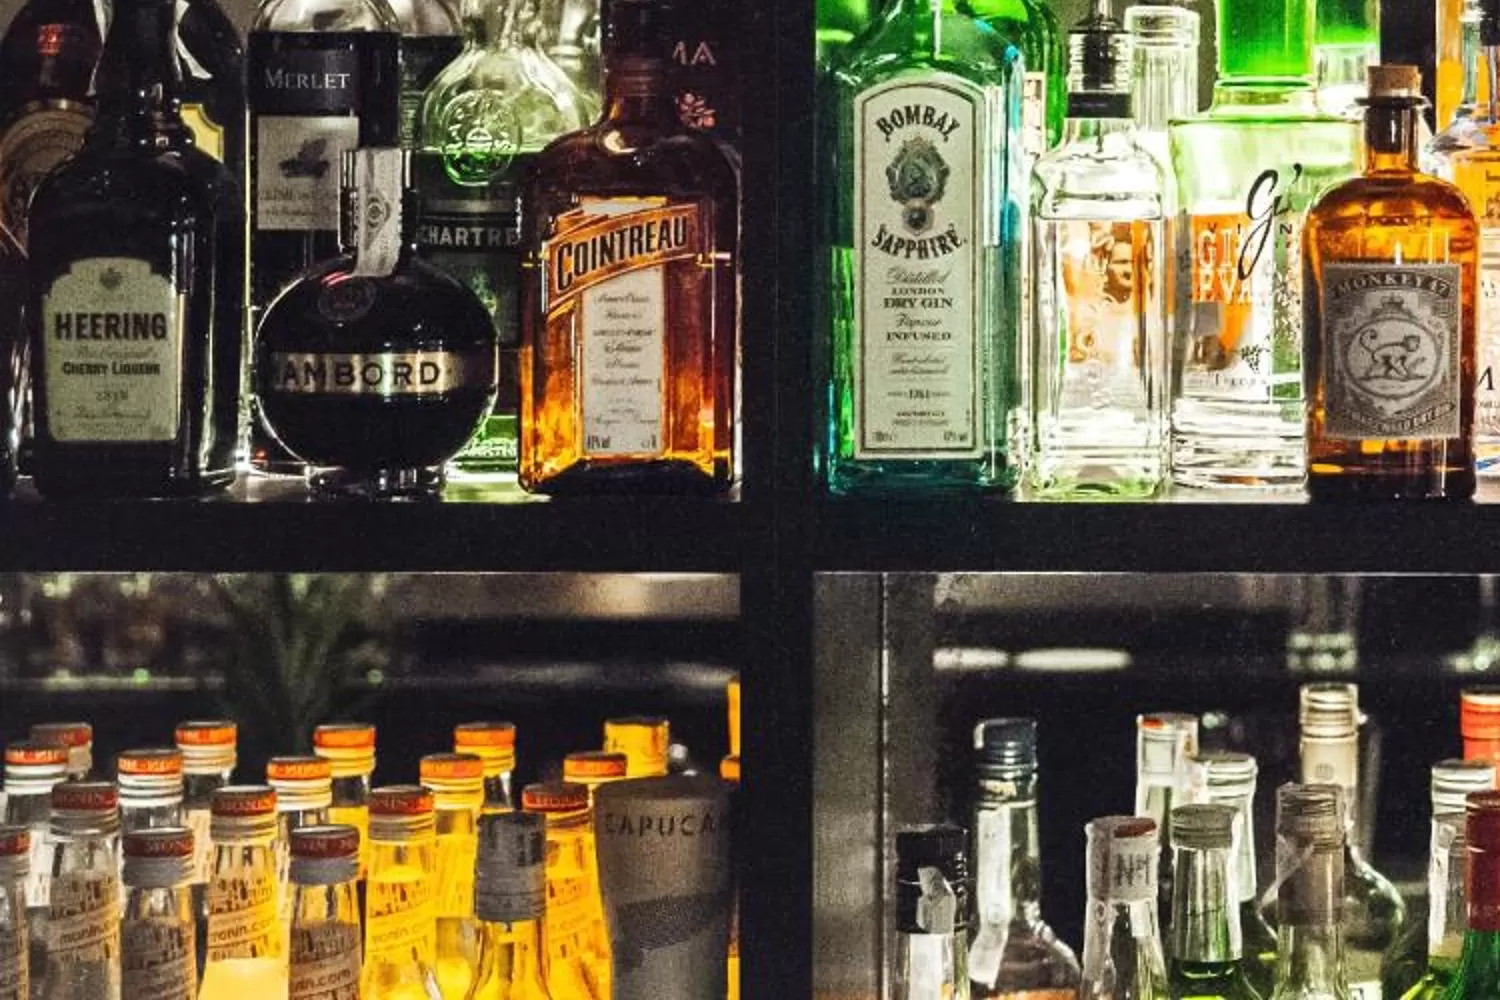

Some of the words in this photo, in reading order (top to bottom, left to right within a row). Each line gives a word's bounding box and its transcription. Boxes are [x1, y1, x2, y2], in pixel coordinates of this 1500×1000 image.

[265, 66, 352, 90] MERLET
[874, 104, 961, 144] BOMBAY
[556, 217, 689, 292] COINTREAU
[1335, 273, 1424, 298] MONKEY
[884, 297, 918, 309] DRY
[920, 297, 953, 309] GIN
[54, 311, 168, 340] HEERING
[886, 331, 952, 341] INFUSED
[62, 360, 109, 376] CHERRY
